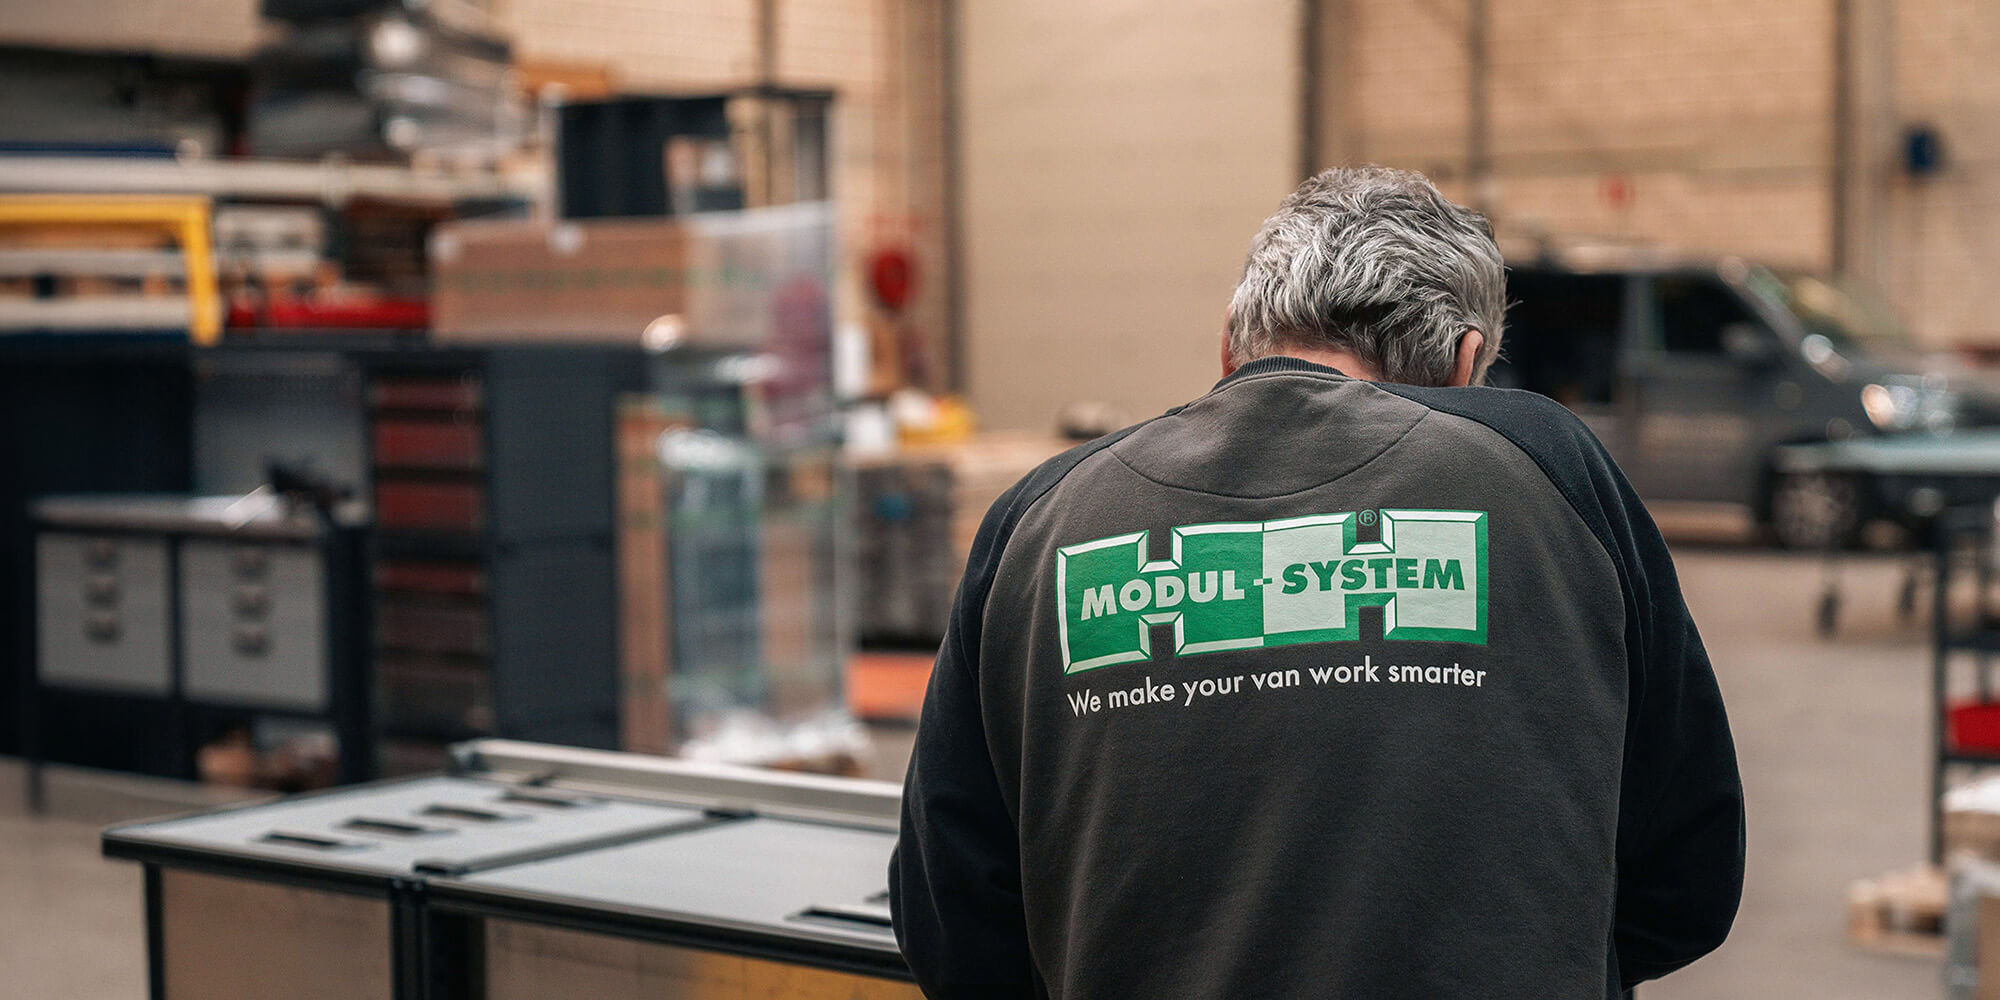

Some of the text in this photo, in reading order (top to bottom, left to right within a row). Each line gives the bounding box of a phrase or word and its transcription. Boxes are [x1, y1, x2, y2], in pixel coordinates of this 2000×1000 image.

[1067, 655, 1487, 717] We make your van work smarter
